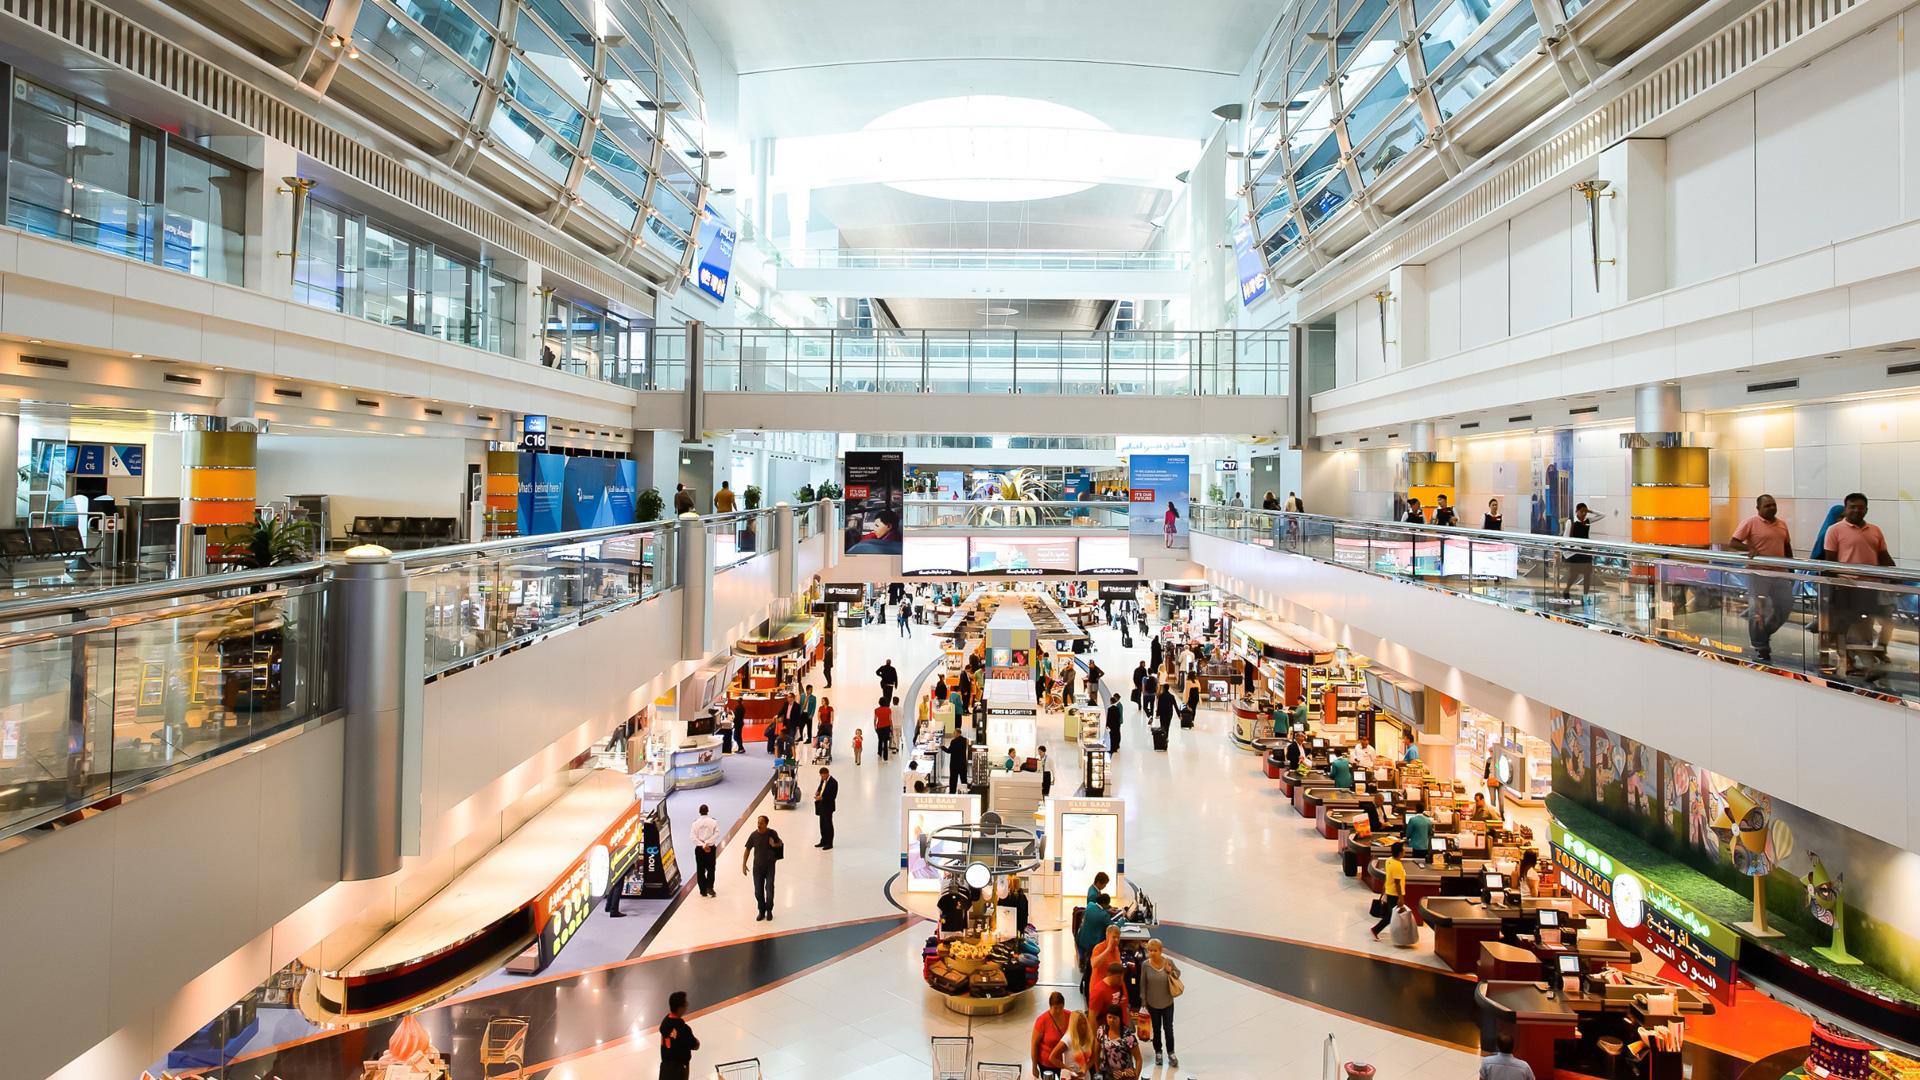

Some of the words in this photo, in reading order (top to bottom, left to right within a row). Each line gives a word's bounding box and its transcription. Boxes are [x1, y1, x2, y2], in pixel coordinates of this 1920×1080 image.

[524, 434, 545, 446] C16
[1224, 462, 1237, 470] C17
[534, 482, 548, 492] behind
[549, 482, 562, 492] here?
[1563, 832, 1613, 875] FOOD
[1555, 847, 1611, 896] TOBACCO
[1560, 871, 1583, 898] DUTY
[1586, 889, 1611, 919] FREE
